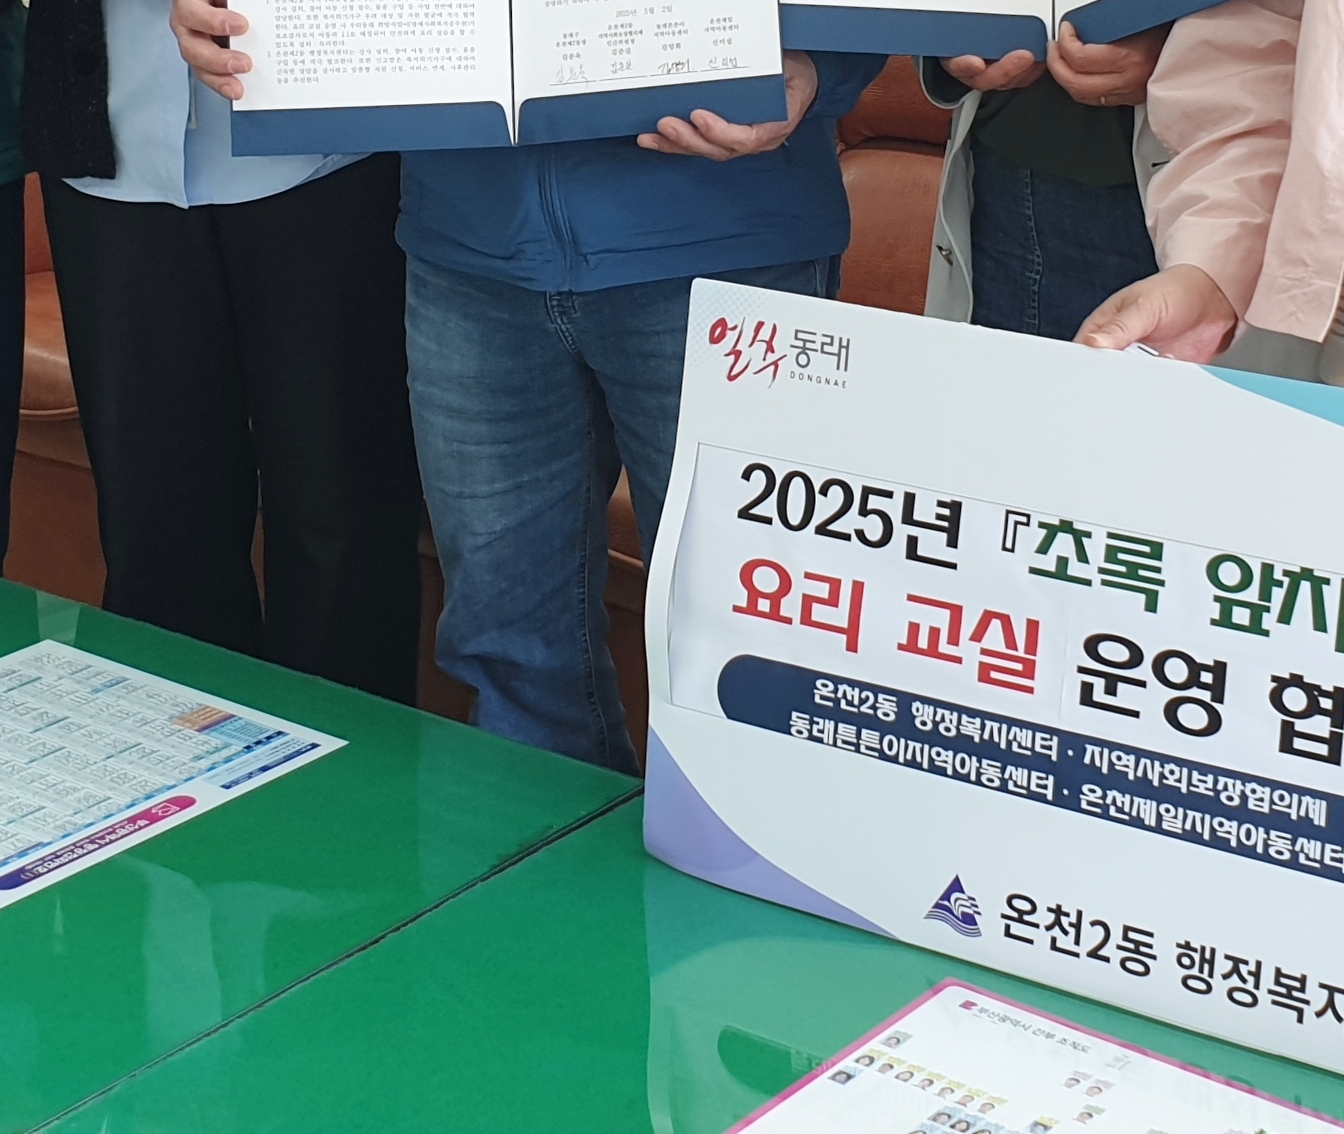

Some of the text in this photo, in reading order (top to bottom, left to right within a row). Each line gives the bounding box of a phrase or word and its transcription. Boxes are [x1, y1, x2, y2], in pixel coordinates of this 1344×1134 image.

[790, 329, 850, 372] 동래
[790, 370, 847, 389] DONGNAE
[736, 461, 965, 573] 2025년
[999, 505, 1169, 615] 『초록
[730, 556, 866, 656] 요리
[895, 590, 1044, 697] 교실
[1075, 630, 1229, 739] 운영
[812, 677, 898, 723] 온천2동
[911, 701, 1059, 762] 행정복지센터
[997, 889, 1159, 978] 온천2동
